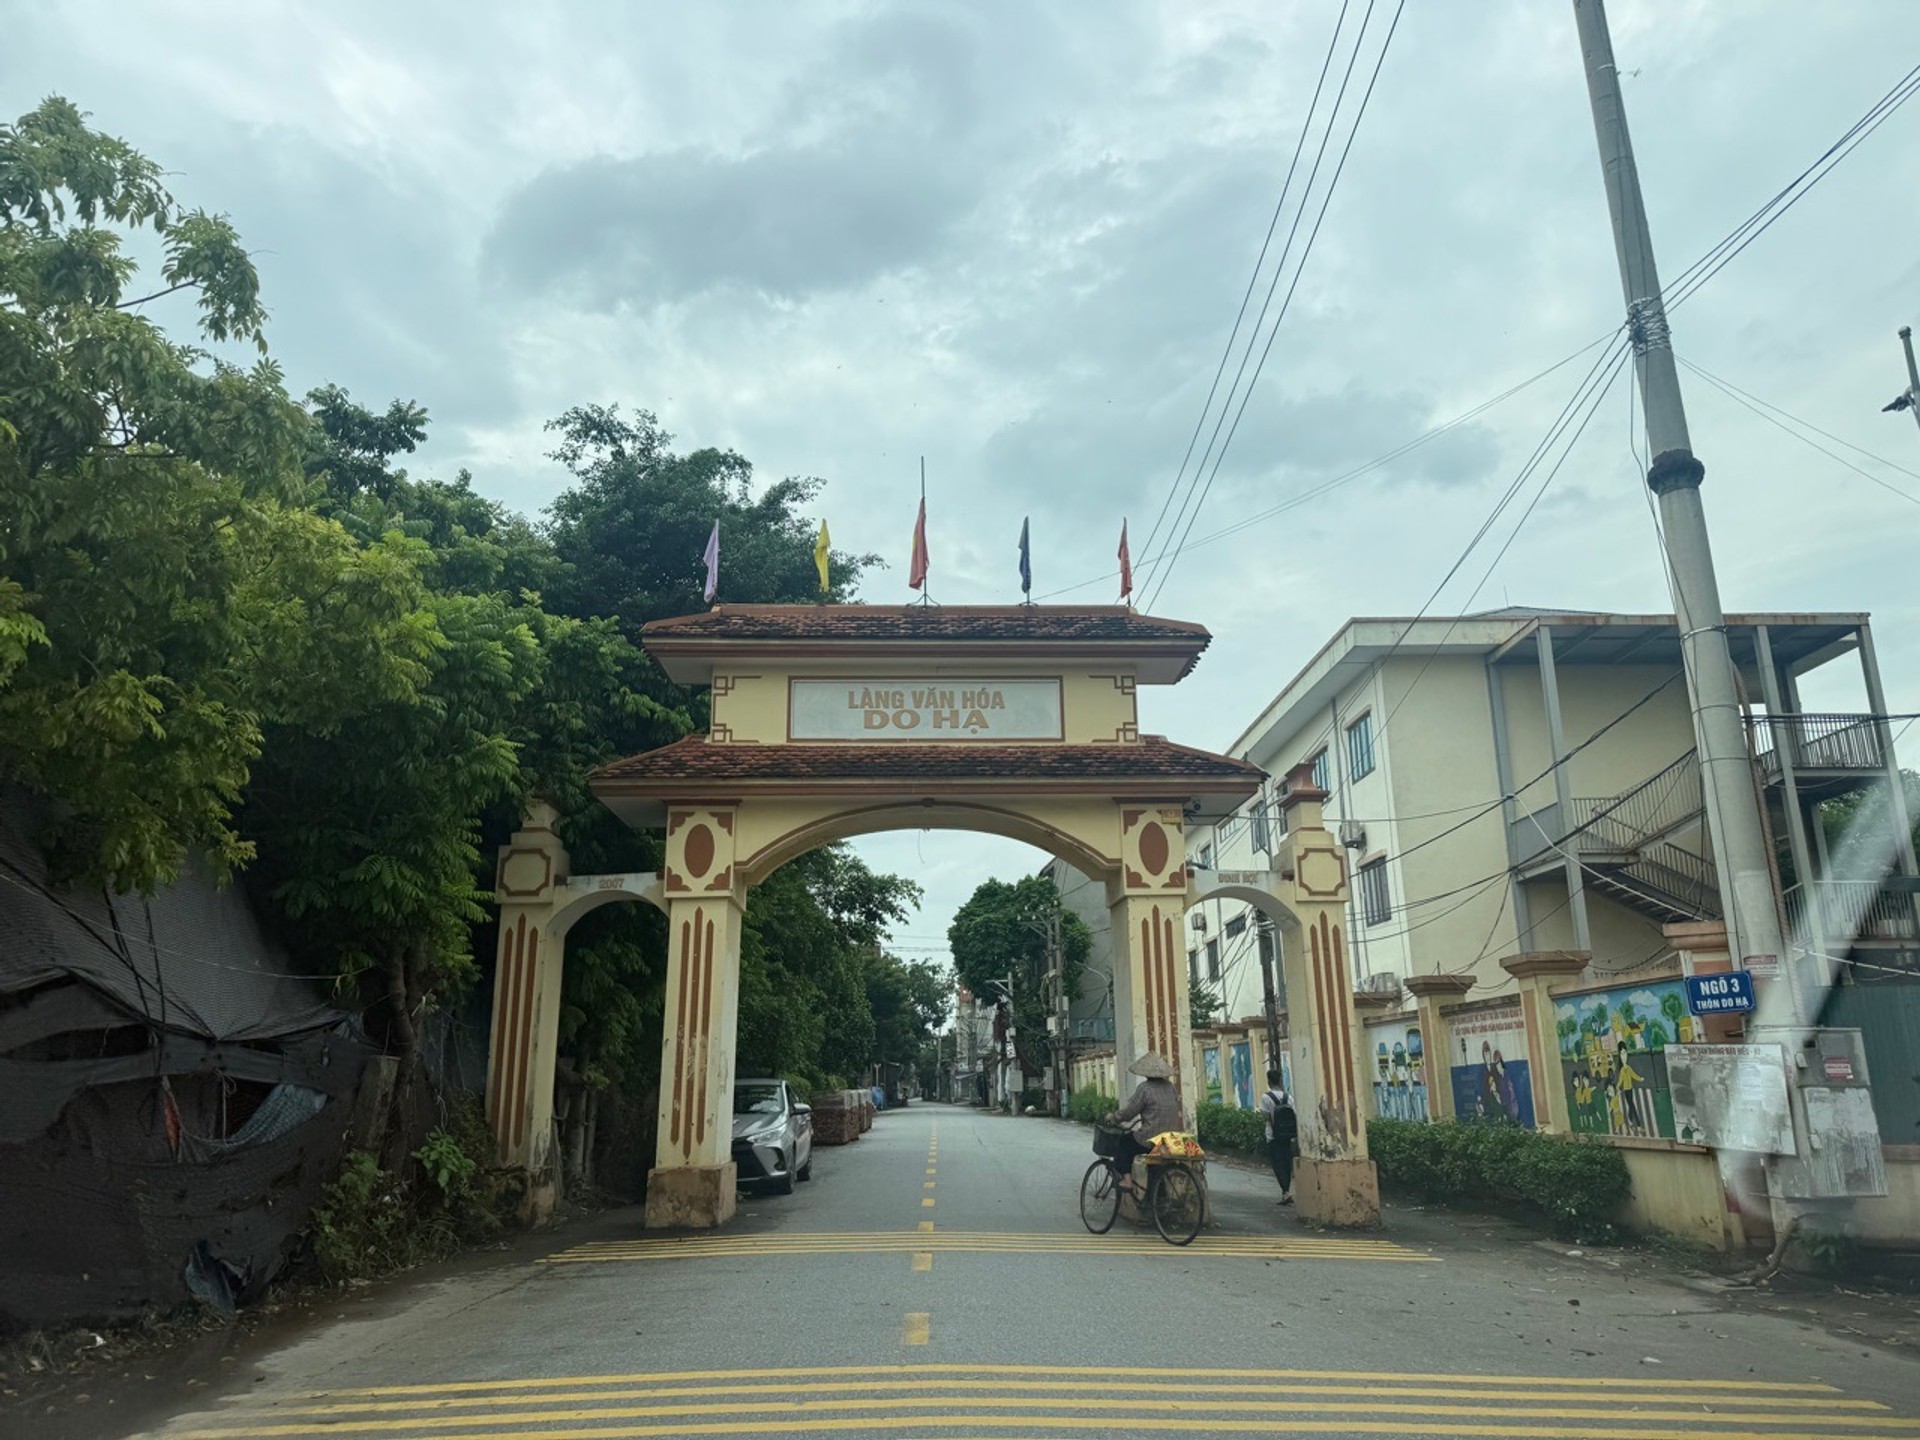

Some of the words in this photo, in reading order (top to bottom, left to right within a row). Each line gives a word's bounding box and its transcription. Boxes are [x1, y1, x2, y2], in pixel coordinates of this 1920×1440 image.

[848, 687, 905, 709] LÀNG
[911, 687, 955, 709] VĂN
[962, 687, 1005, 709] HÓA
[863, 709, 921, 730] DO
[933, 709, 990, 735] HẠ
[599, 878, 625, 889] 2007
[1700, 977, 1728, 996] NGÕ
[1730, 978, 1740, 993] 3
[1696, 998, 1720, 1010] THÔN
[1735, 996, 1749, 1008] HẠ
